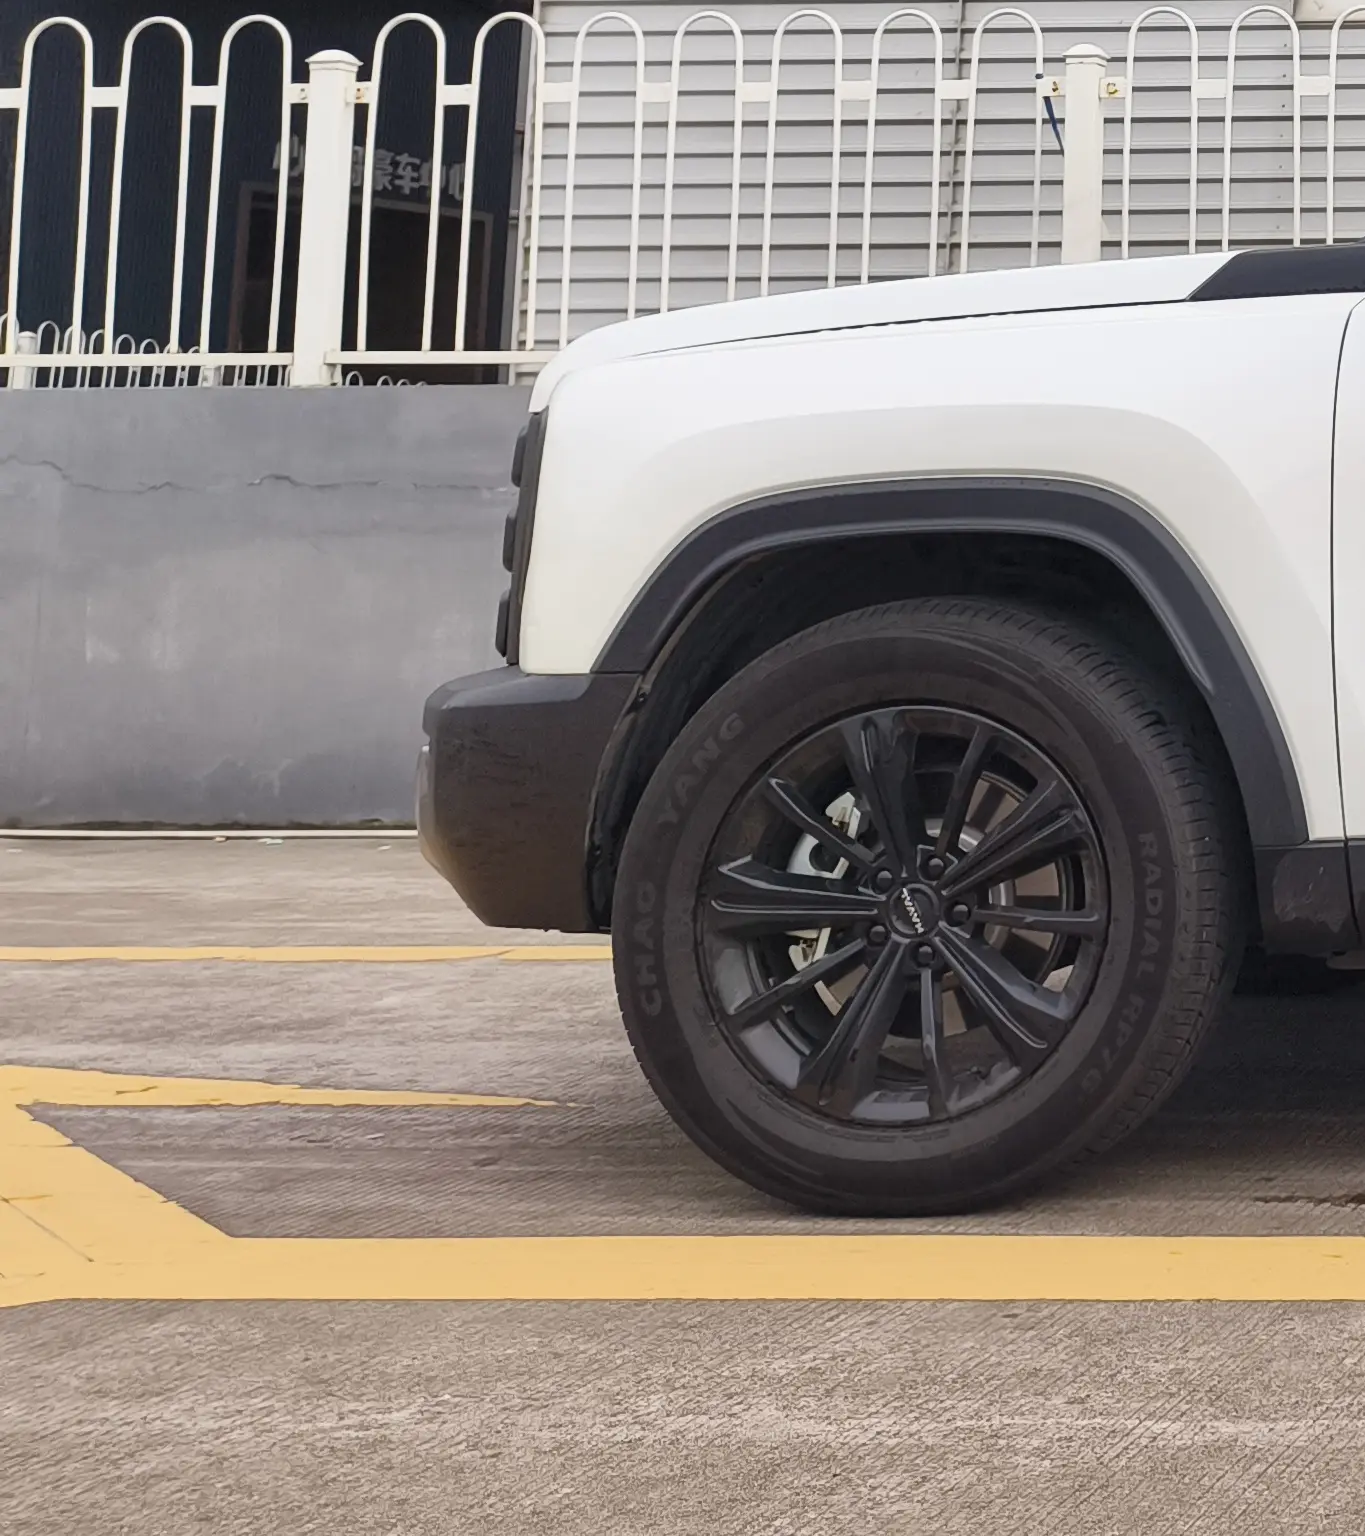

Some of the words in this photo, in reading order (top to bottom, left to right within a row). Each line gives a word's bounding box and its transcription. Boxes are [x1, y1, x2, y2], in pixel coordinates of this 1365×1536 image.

[632, 880, 663, 1017] CHAO
[656, 711, 746, 827] YANG
[901, 887, 925, 934] HAVAL
[1136, 831, 1164, 979] RADIAL
